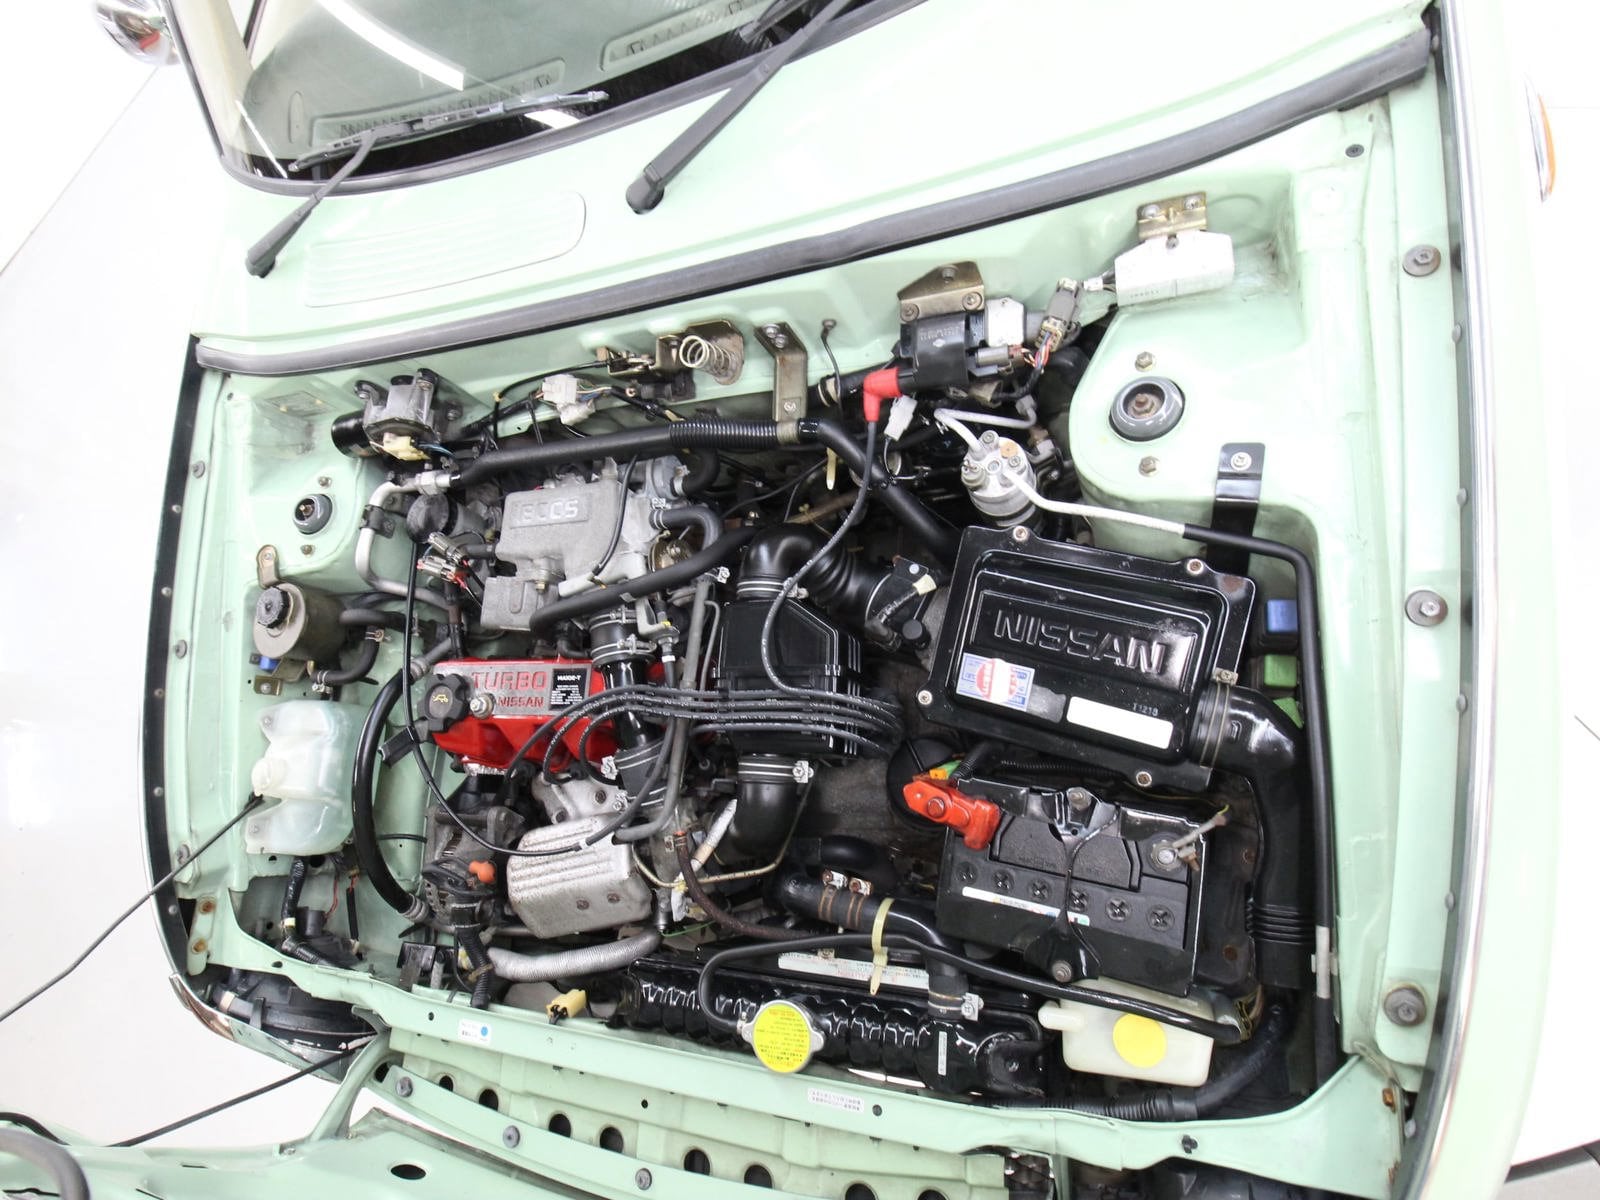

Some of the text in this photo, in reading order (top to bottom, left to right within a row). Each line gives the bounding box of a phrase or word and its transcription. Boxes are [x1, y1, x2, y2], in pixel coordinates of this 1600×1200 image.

[994, 610, 1167, 673] NISSAN
[471, 671, 547, 690] TURBO
[497, 696, 544, 707] NISSAN
